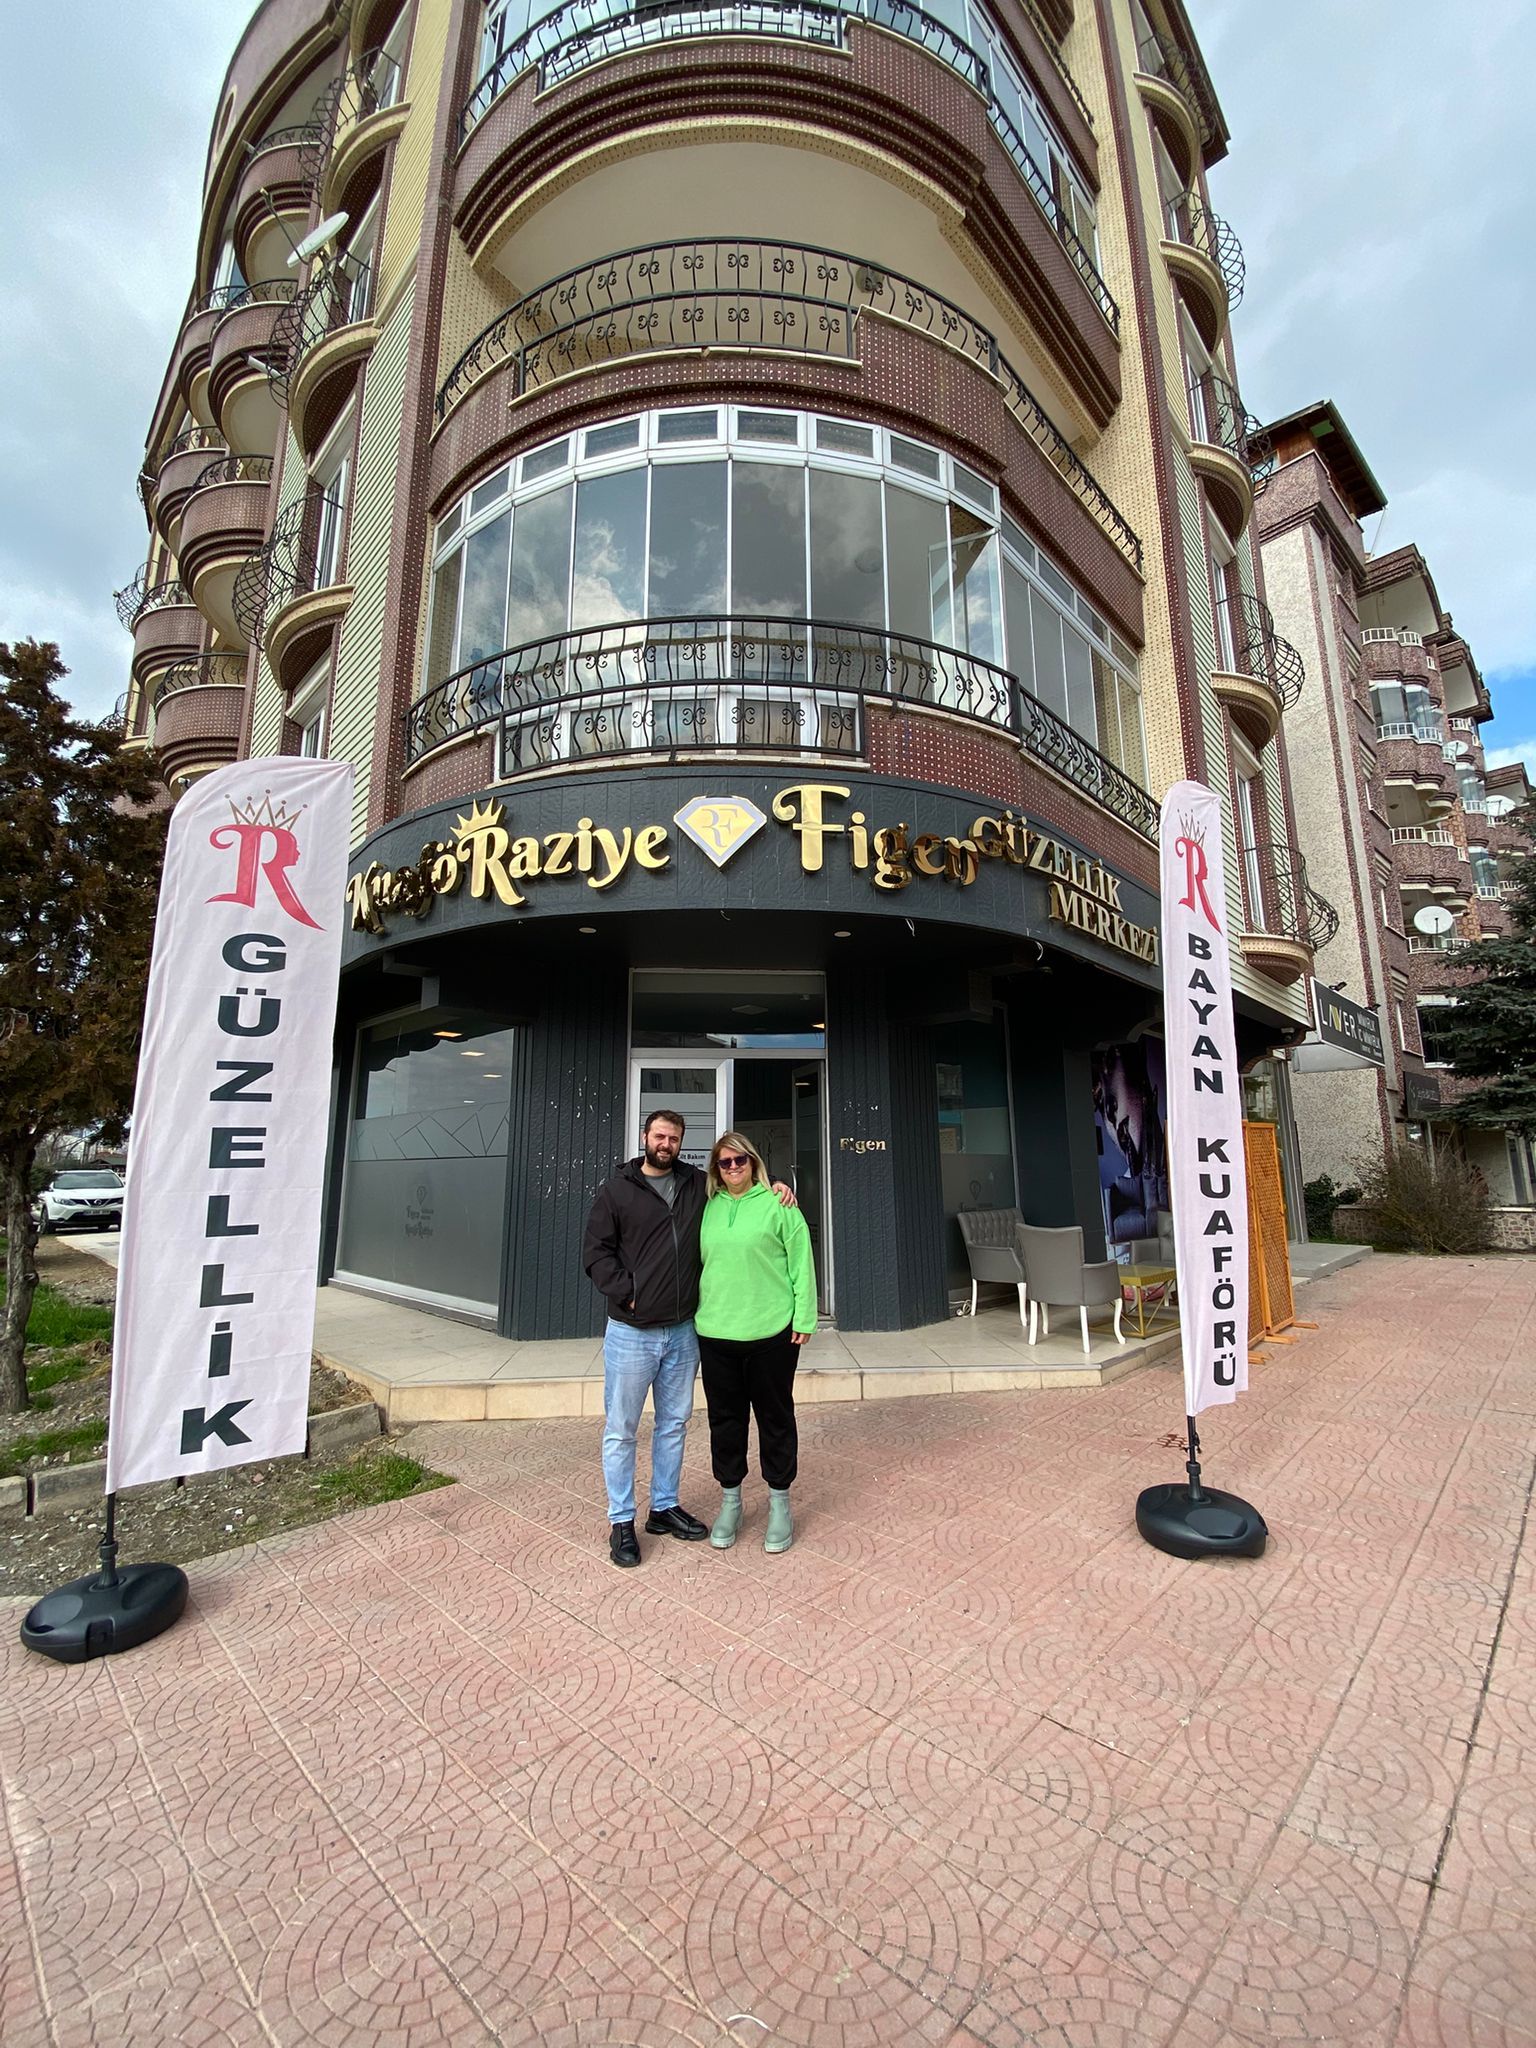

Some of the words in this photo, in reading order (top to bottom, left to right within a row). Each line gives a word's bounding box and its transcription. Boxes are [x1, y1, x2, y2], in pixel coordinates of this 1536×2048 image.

[456, 817, 671, 906] Raziye
[772, 784, 979, 889] Figen
[968, 810, 1123, 912] GÜZELLİK
[1048, 881, 1160, 967] MERKEZİ
[1188, 932, 1225, 1094] BAYAN
[179, 933, 286, 1455] GÜZELLİK
[1197, 1137, 1236, 1386] KUAFÖRÜ
